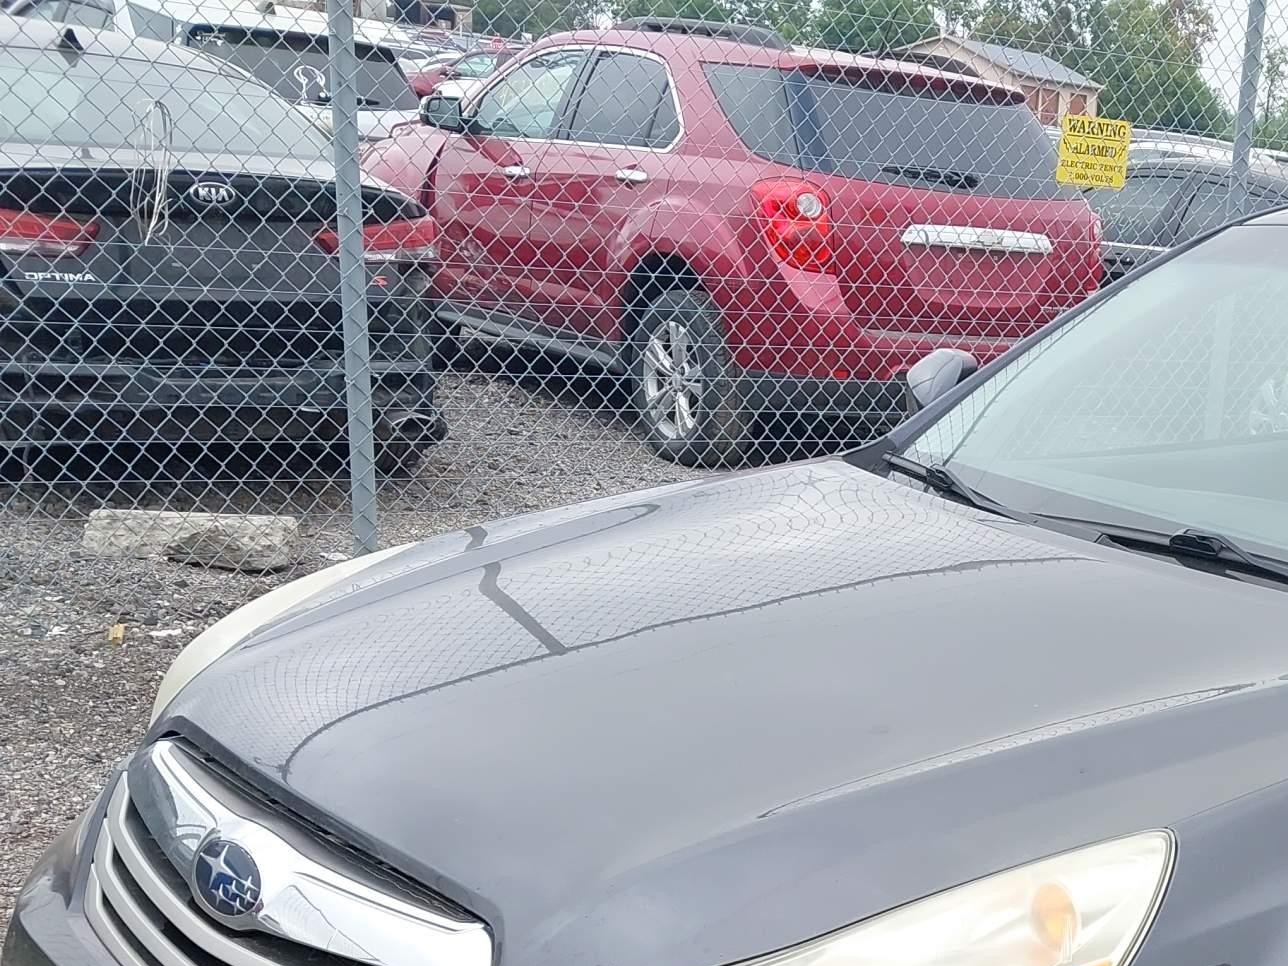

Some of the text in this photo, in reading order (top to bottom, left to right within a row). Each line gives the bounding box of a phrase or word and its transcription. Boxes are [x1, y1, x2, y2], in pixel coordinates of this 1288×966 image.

[1068, 118, 1127, 138] WARNING
[1071, 143, 1117, 159] ALARMED
[1061, 159, 1098, 171] ELECTRIC
[197, 187, 229, 201] KIA
[25, 272, 96, 285] OPTIMA
